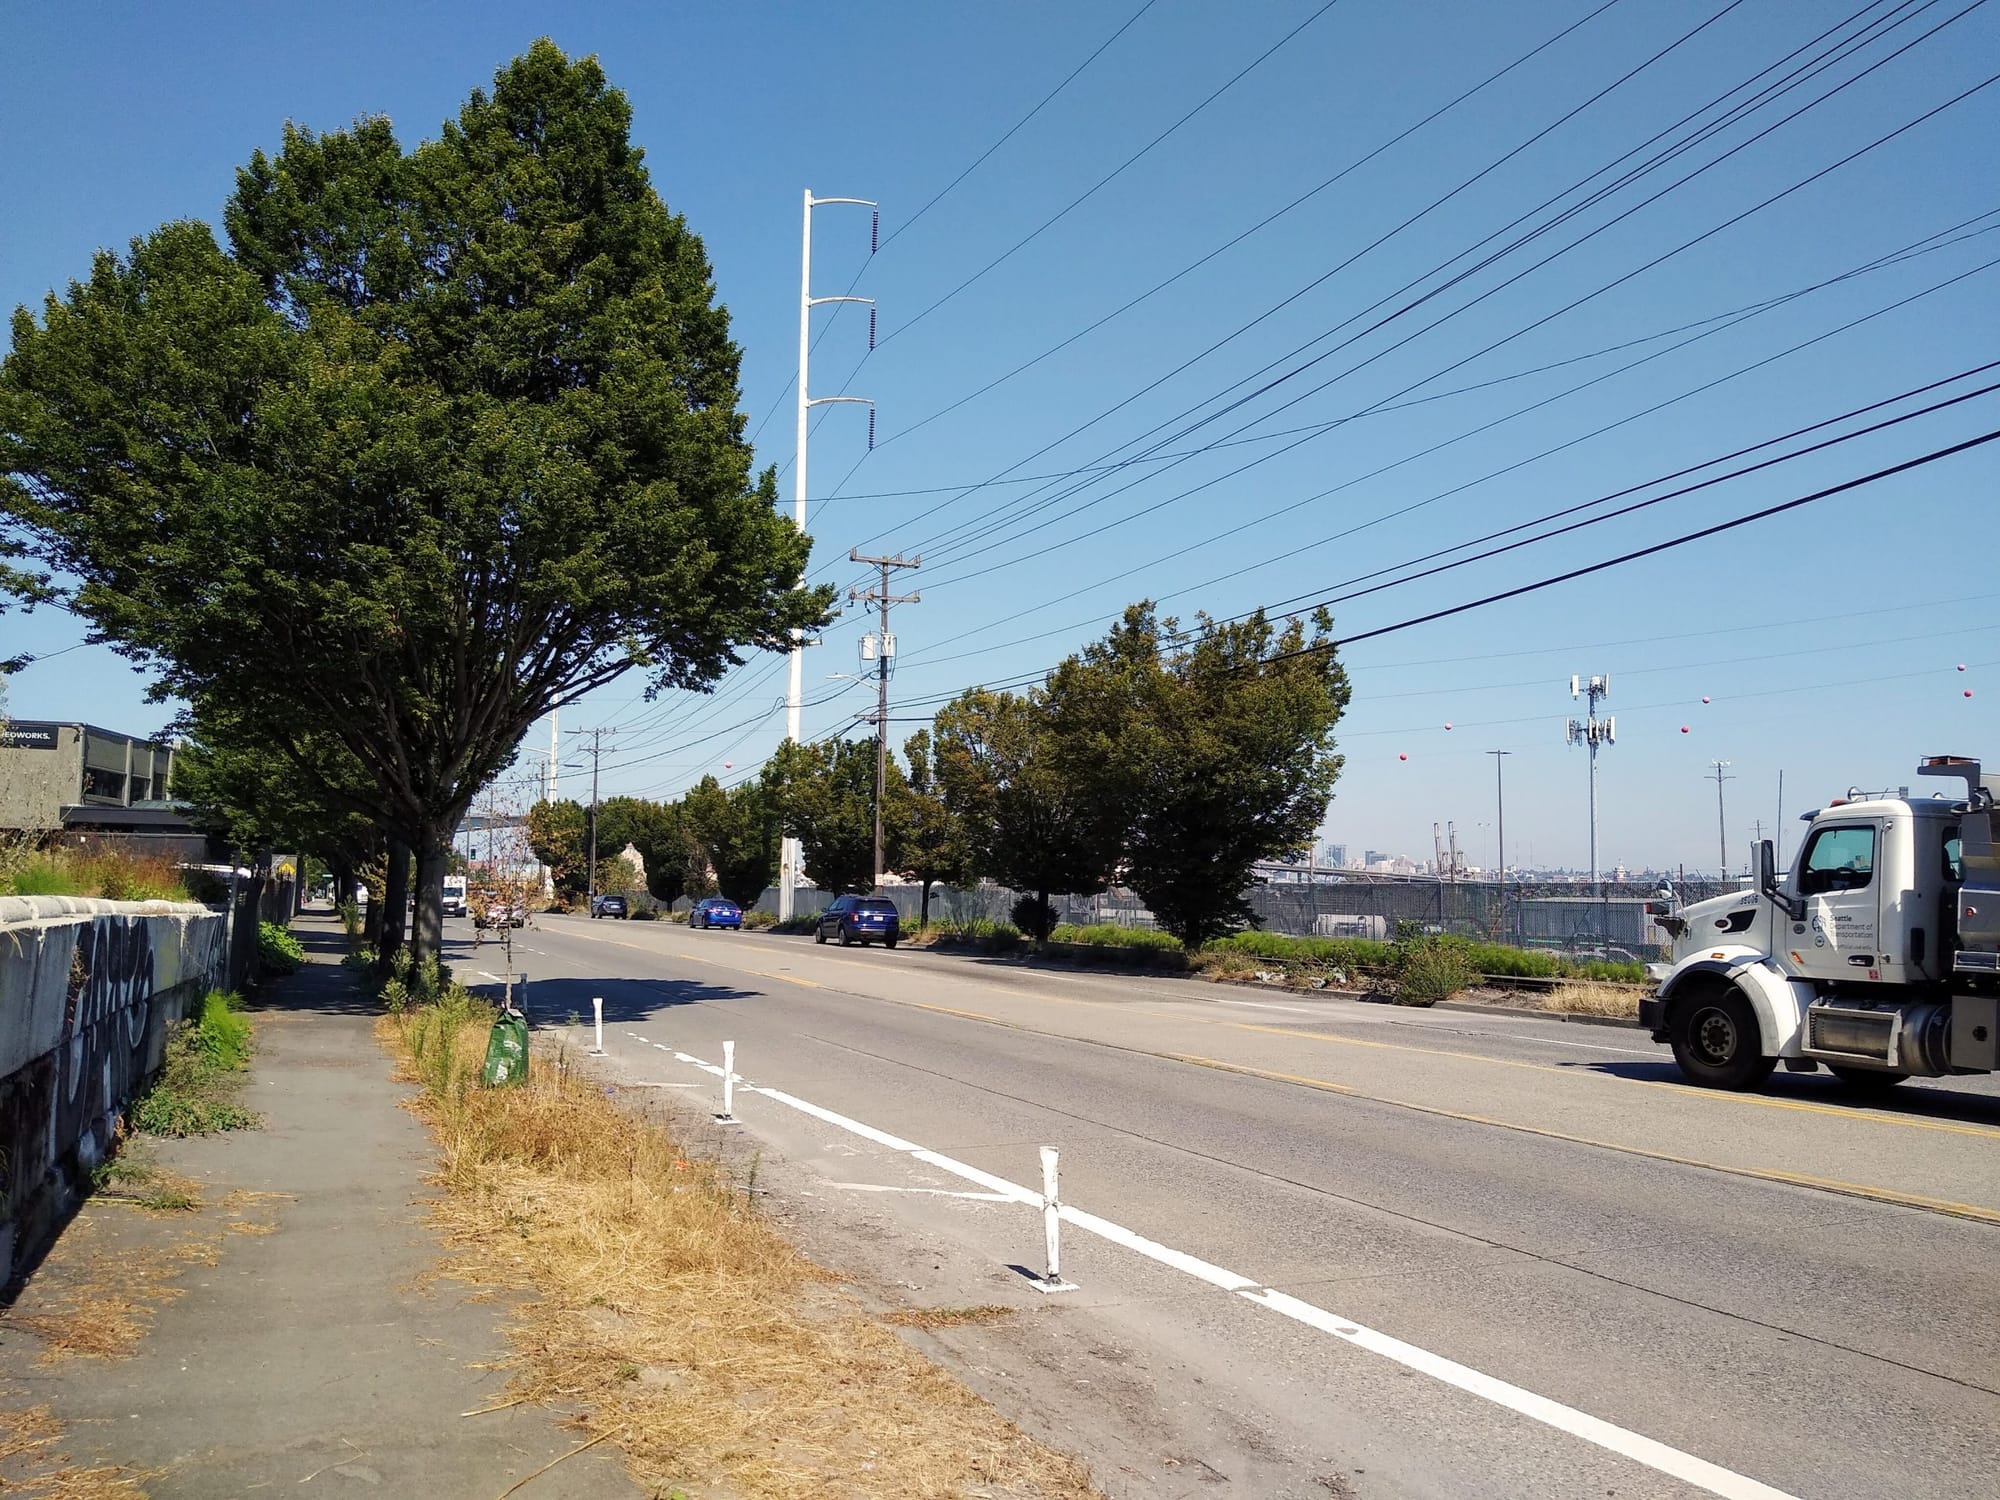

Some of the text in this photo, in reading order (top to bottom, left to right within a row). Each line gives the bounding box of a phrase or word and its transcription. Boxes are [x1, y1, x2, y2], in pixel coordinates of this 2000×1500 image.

[1830, 914, 1852, 922] Seattle
[1830, 923, 1873, 931] Department of
